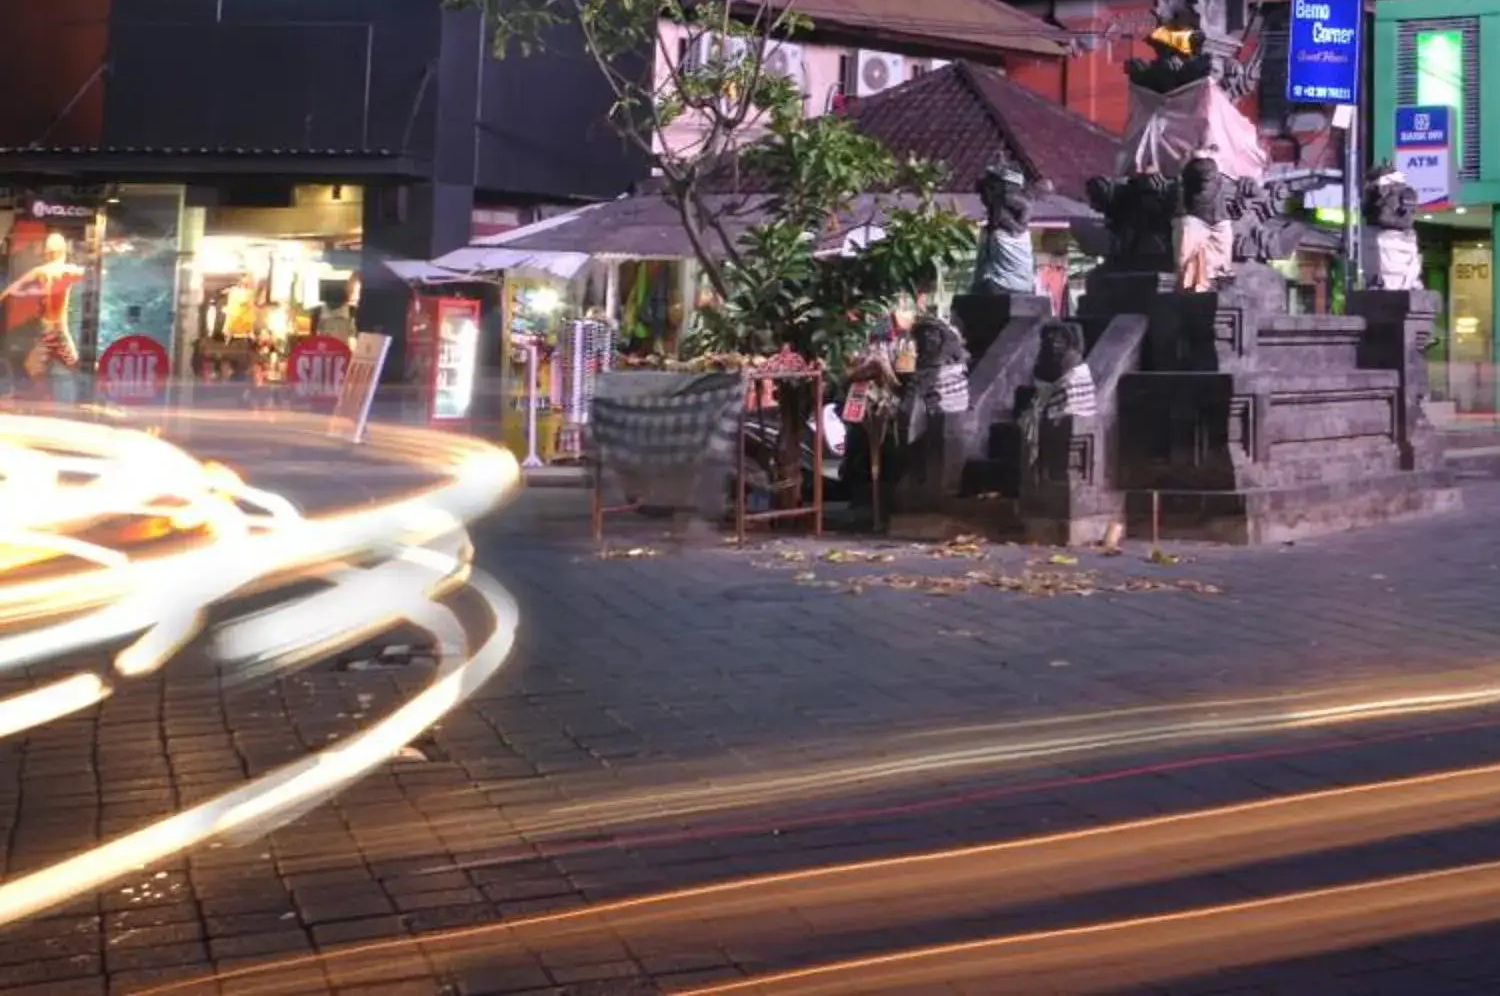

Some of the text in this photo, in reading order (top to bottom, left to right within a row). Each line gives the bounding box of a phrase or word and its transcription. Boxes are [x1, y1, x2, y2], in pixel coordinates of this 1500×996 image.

[1313, 21, 1354, 44] Corner
[1407, 156, 1438, 167] ATM
[107, 355, 157, 395] SALE
[296, 355, 345, 396] SALE
